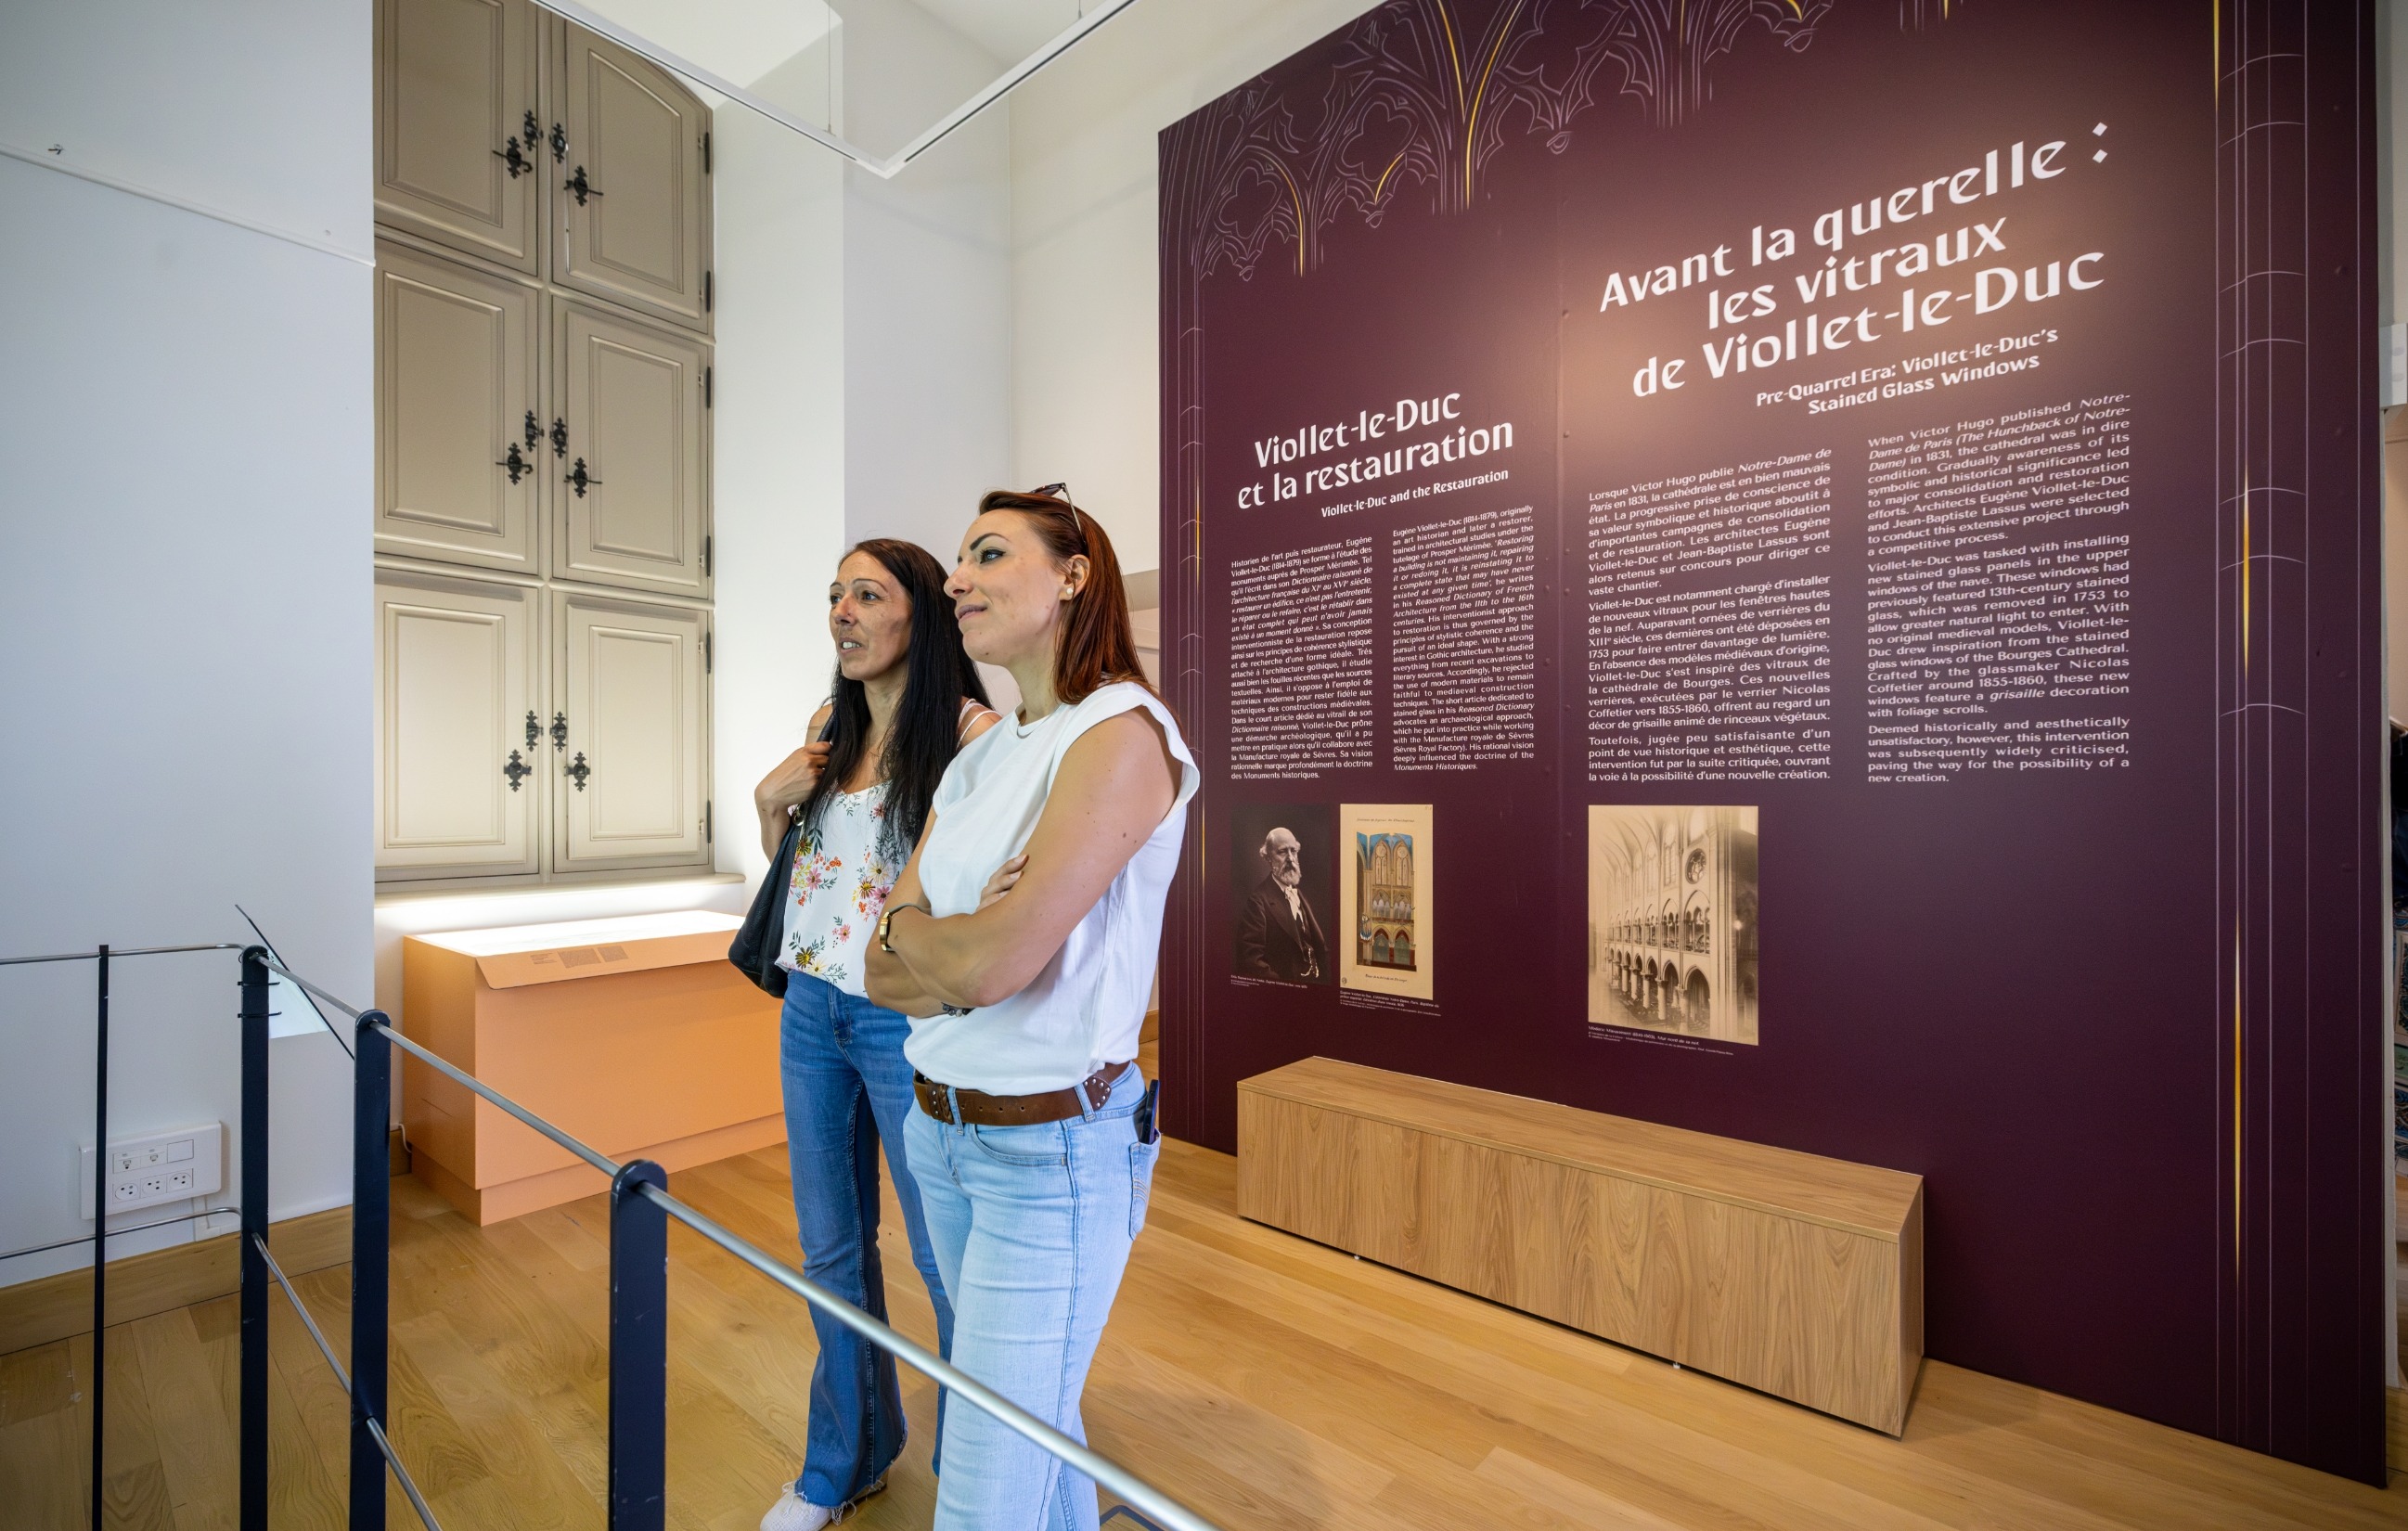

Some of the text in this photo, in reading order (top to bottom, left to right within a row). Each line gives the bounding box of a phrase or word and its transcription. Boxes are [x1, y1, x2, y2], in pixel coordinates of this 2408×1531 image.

[1599, 122, 2108, 313] Avant la querelle :
[1707, 216, 2006, 329] les vitraux
[1633, 251, 2105, 396] de Viollet-le-Duc
[1757, 371, 1857, 406] Pre-Quarrel
[1861, 363, 1897, 385] Era:
[1808, 354, 2040, 415] Stained Glass Windows
[1255, 392, 1461, 469] Viollet-le-Duc
[1867, 393, 2131, 447] When Victor Hugo published Notre-
[1238, 421, 1513, 509] et la restauration
[1589, 448, 1832, 501] Lorsque Victor Hugo publie Notre-Dame de
[1867, 445, 2130, 497] symbolic and historical significance led
[1321, 470, 1509, 518] Viollet-le-Duc and the Restauration
[1589, 475, 1831, 525] état. La progressive prise de conscience de
[1867, 486, 2130, 532] and Jean-Baptiste Lassus were selected
[1416, 531, 1449, 542] historian
[1451, 526, 1466, 535] and
[1469, 523, 1487, 532] later
[1499, 515, 1533, 527] restorer,
[1589, 517, 1830, 560] et de restauration. Les architectes Eugène
[1867, 532, 2008, 557] a competitive process.
[1230, 574, 1266, 586] monuments
[1299, 565, 1325, 574] Prosper
[1361, 555, 1372, 563] Tel
[1867, 560, 2130, 597] windows of the nave. These windows had
[1588, 580, 1662, 596] vaste chantier.
[1393, 617, 1425, 627] centuries.
[1443, 608, 1495, 621] interventionist
[1498, 603, 1534, 615] approach
[1867, 601, 2129, 633] allow greater natural light to enter. With
[1230, 638, 1283, 650] interventionniste
[1304, 631, 1346, 642] restauration
[1347, 628, 1372, 637] repose
[1393, 654, 1418, 663] interest
[1426, 650, 1449, 660] Gothic
[1450, 648, 1494, 658] architecture,
[1506, 642, 1534, 652] studied
[1589, 630, 1830, 660] 1753 pour faire entrer davantage de lumière.
[1417, 671, 1445, 679] sources.
[1446, 666, 1490, 676] Accordingly,
[1502, 662, 1534, 673] rejected
[1230, 697, 1261, 705] matériaux
[1263, 695, 1294, 703] modernes
[1296, 694, 1312, 702] pour
[1314, 691, 1334, 700] rester
[1393, 690, 1420, 699] faithful
[1436, 686, 1476, 696] mediaeval
[1480, 682, 1534, 693] construction
[1588, 684, 1831, 706] verrières, exécutées par le verrier Nicolas
[1230, 706, 1266, 715] techniques
[1281, 701, 1328, 712] constructions
[1330, 699, 1372, 708] médiévales.
[1867, 704, 1988, 718] with foliage scrolls.
[1239, 753, 1279, 761] Manufacture
[1280, 752, 1300, 761] royale
[1351, 749, 1372, 757] vision
[1435, 763, 1477, 771] Historiques.
[1243, 771, 1281, 779] Monuments
[1281, 770, 1320, 779] historiques.
